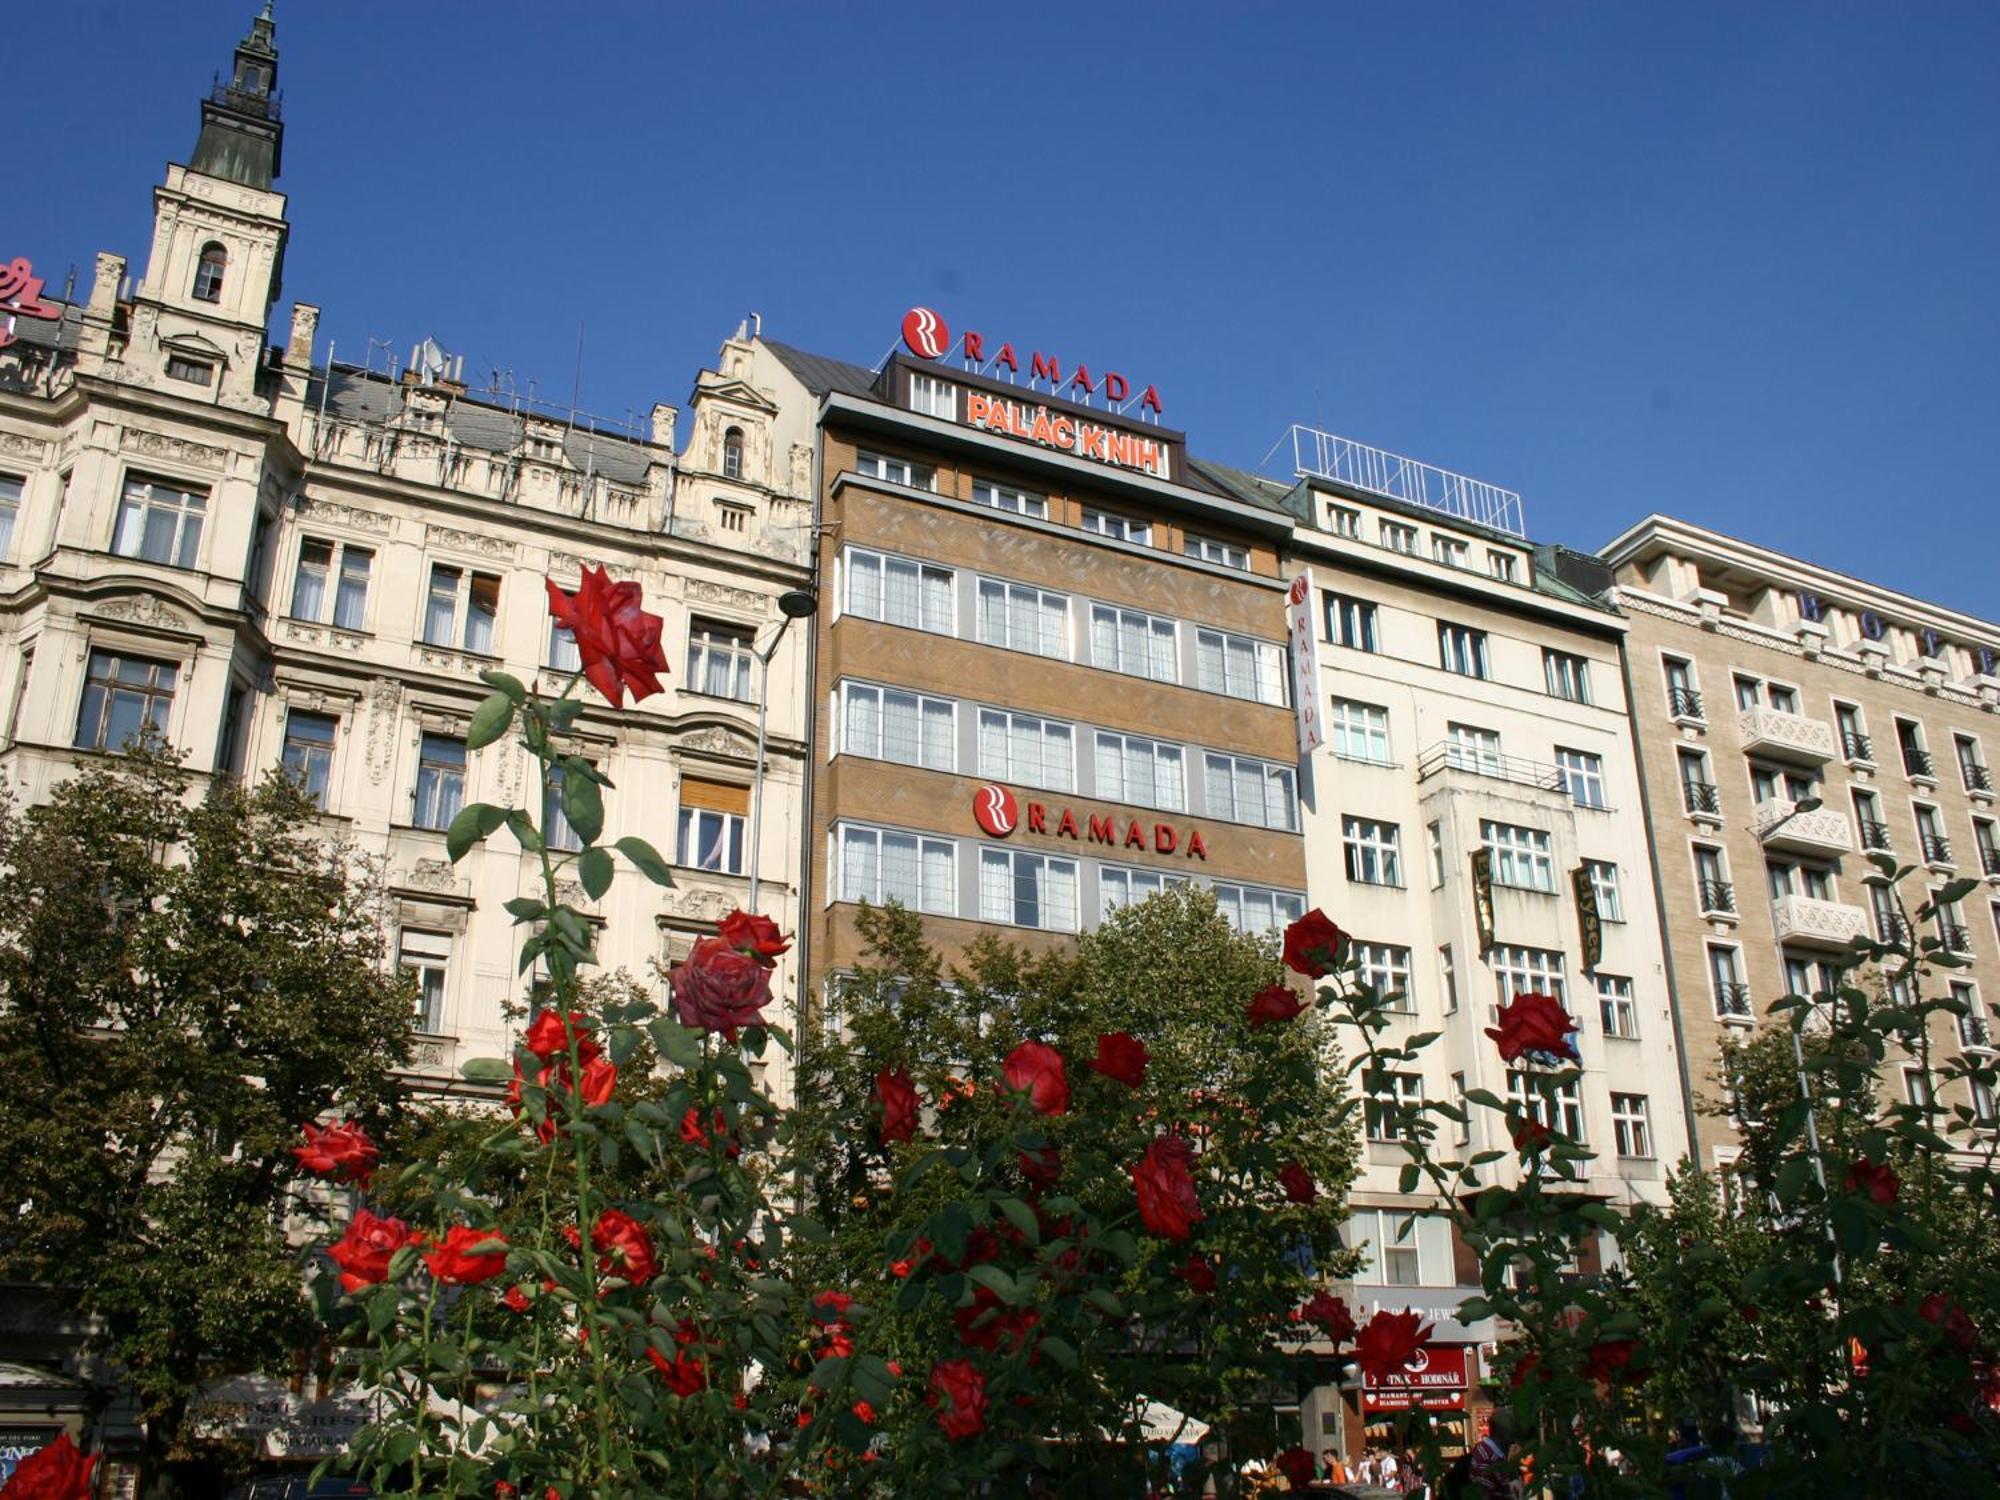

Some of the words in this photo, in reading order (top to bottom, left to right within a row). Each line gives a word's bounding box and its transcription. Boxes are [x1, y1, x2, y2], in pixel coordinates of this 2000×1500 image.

[964, 330, 1163, 414] RAMADA
[968, 394, 1075, 449] PALÁC
[1083, 424, 1160, 472] KNIH
[1297, 617, 1316, 748] RAMADA
[1027, 801, 1209, 861] RAMADA
